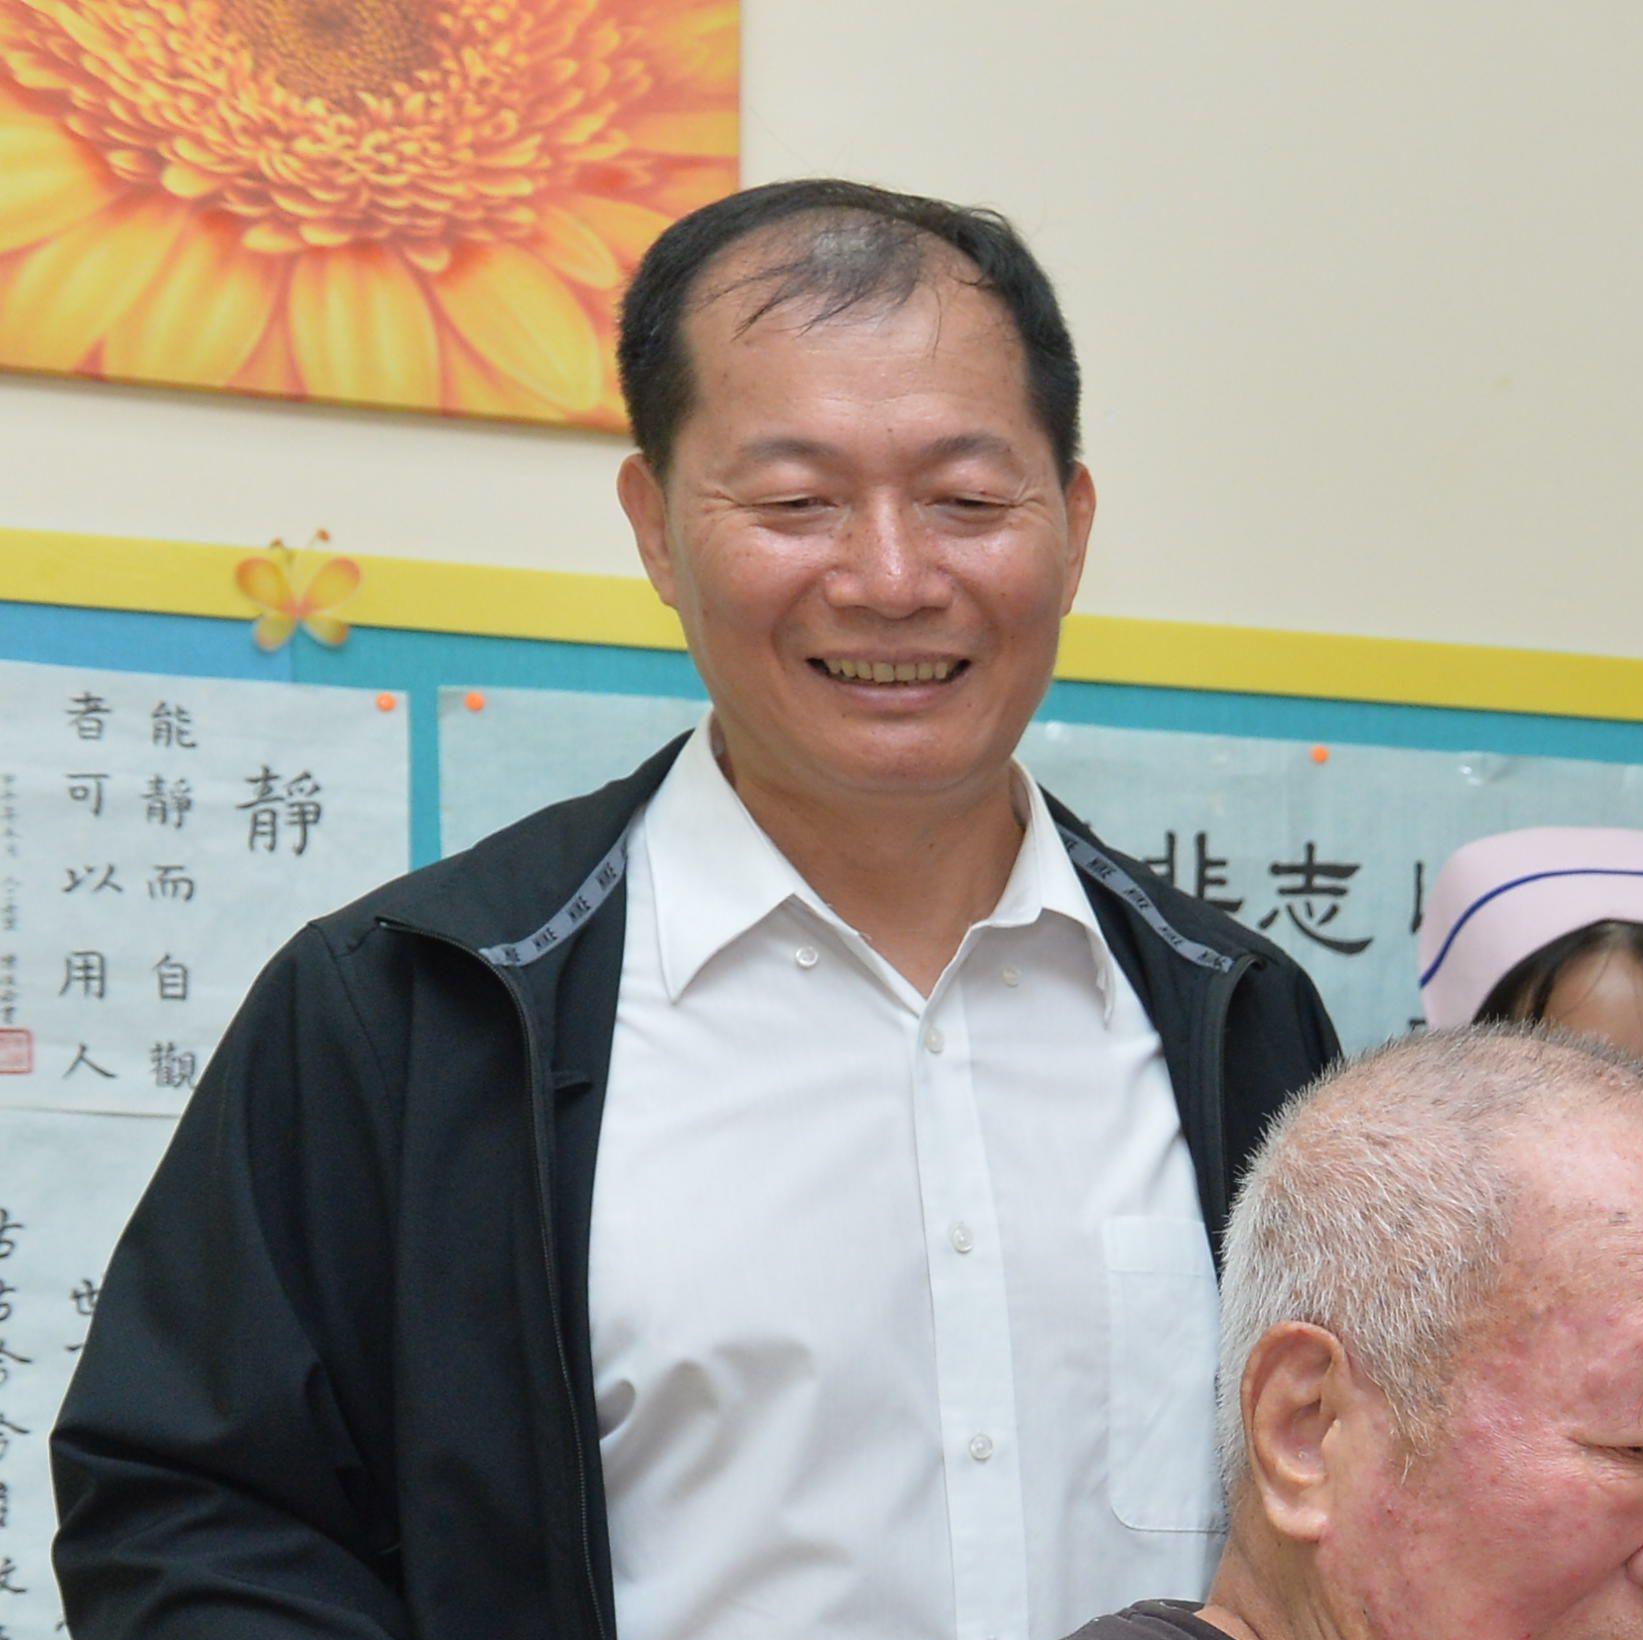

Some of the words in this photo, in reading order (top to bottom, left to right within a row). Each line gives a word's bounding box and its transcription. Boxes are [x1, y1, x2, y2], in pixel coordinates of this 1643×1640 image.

[59, 691, 124, 1080] 者可以用人
[140, 700, 198, 1089] 能靜而自觀
[236, 764, 322, 856] 靜
